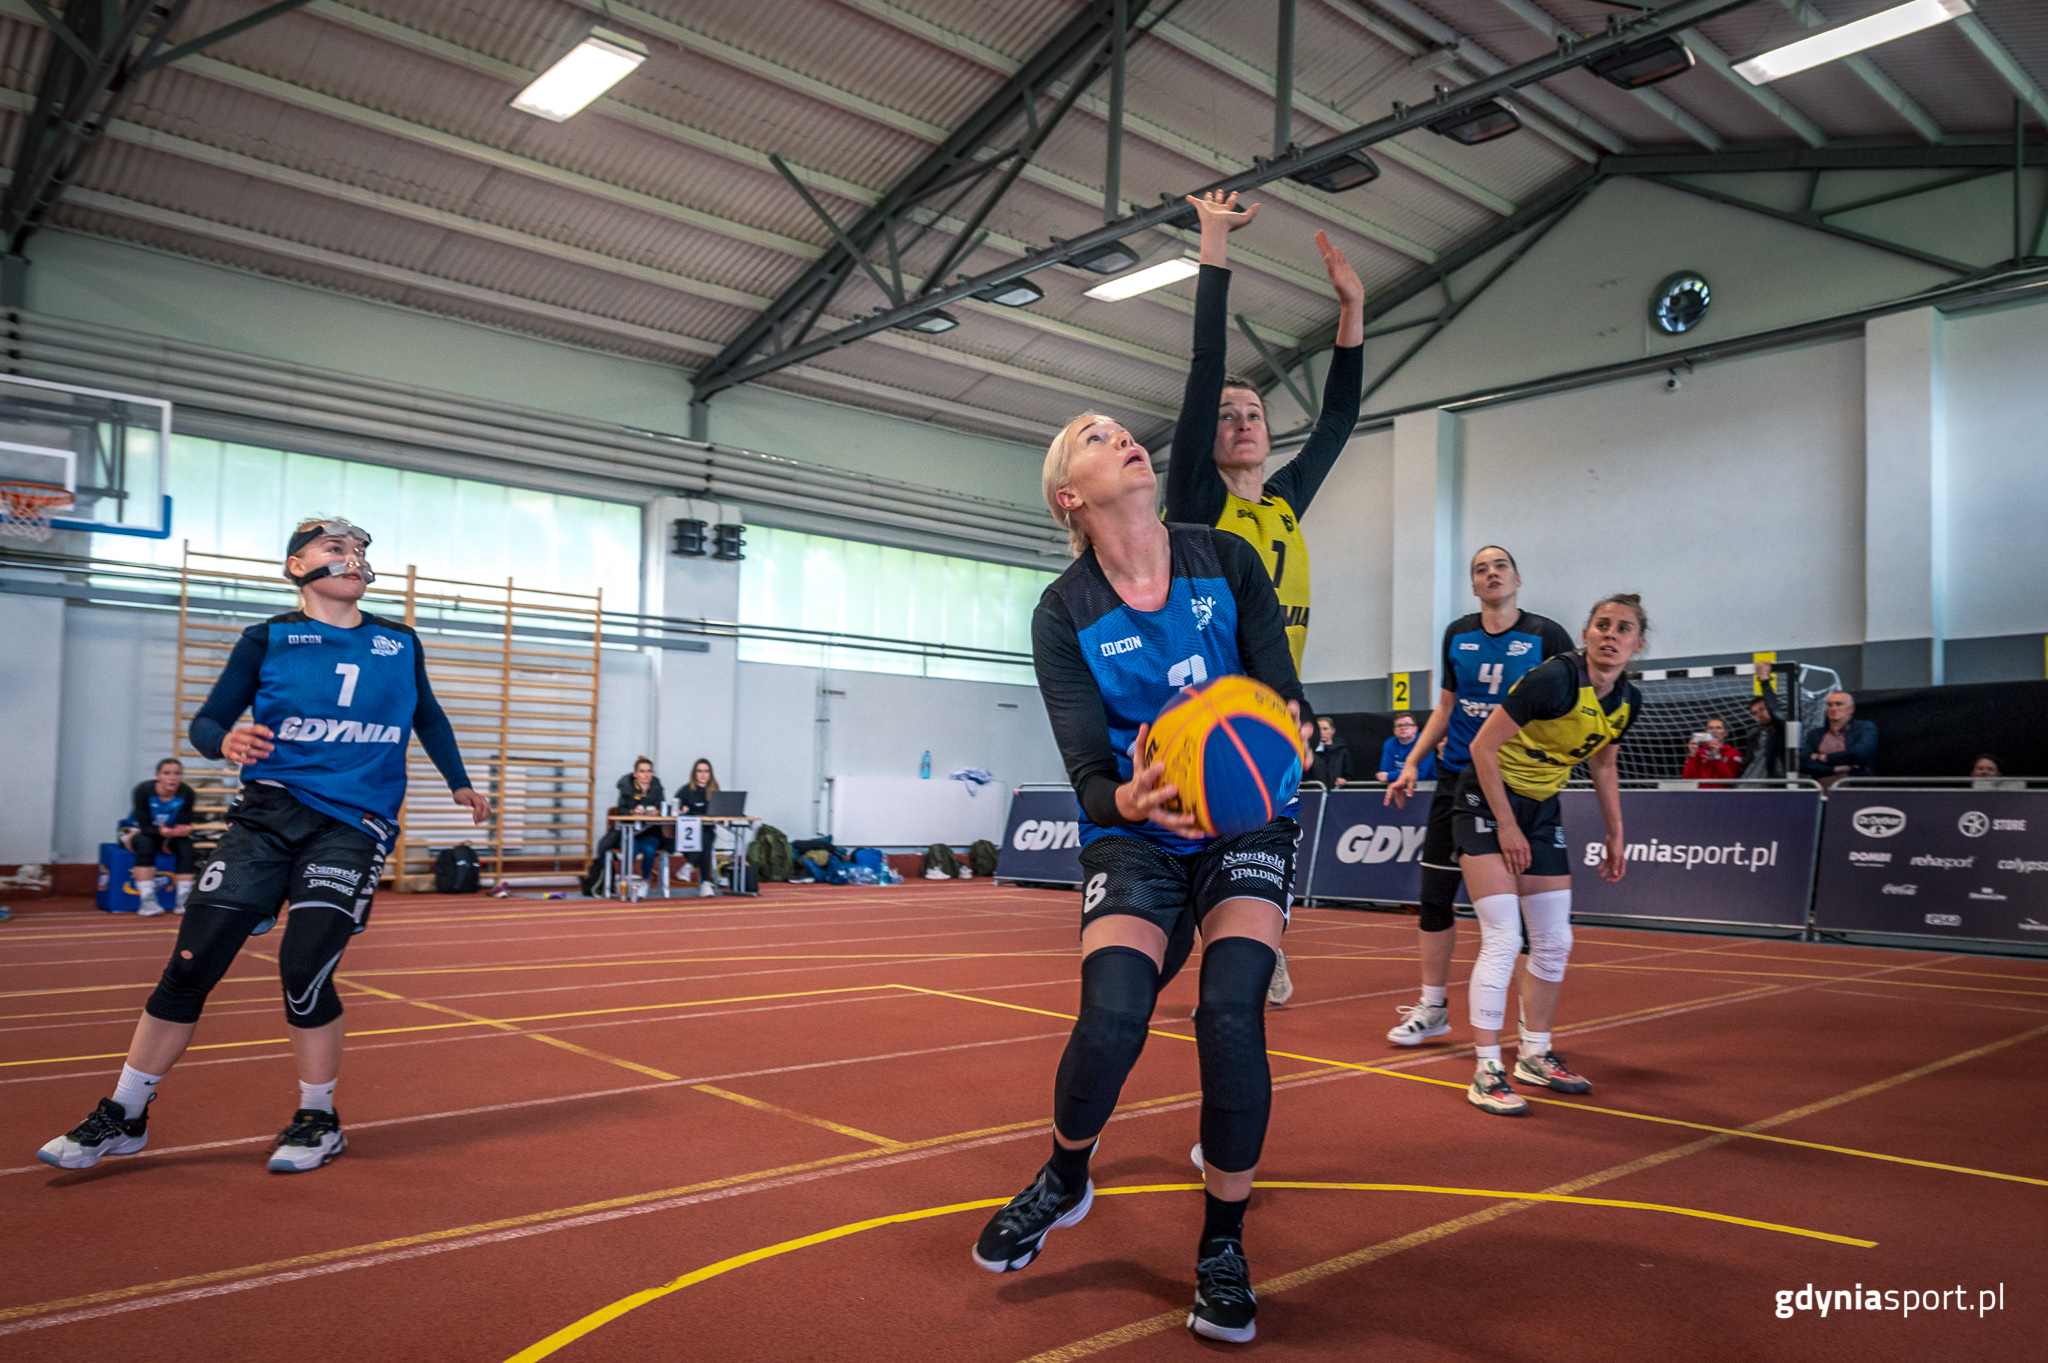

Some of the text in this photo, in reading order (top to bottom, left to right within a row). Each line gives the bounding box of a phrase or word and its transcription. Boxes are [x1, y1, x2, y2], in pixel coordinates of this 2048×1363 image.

[1114, 635, 1143, 655] ICON
[1477, 663, 1504, 695] 4
[1395, 681, 1408, 702] 2
[277, 716, 401, 744] GDYNIA
[684, 826, 694, 841] 2
[199, 861, 226, 892] 6
[307, 878, 355, 897] SPALDING
[1230, 868, 1283, 890] SPALDING
[1083, 872, 1108, 914] 8
